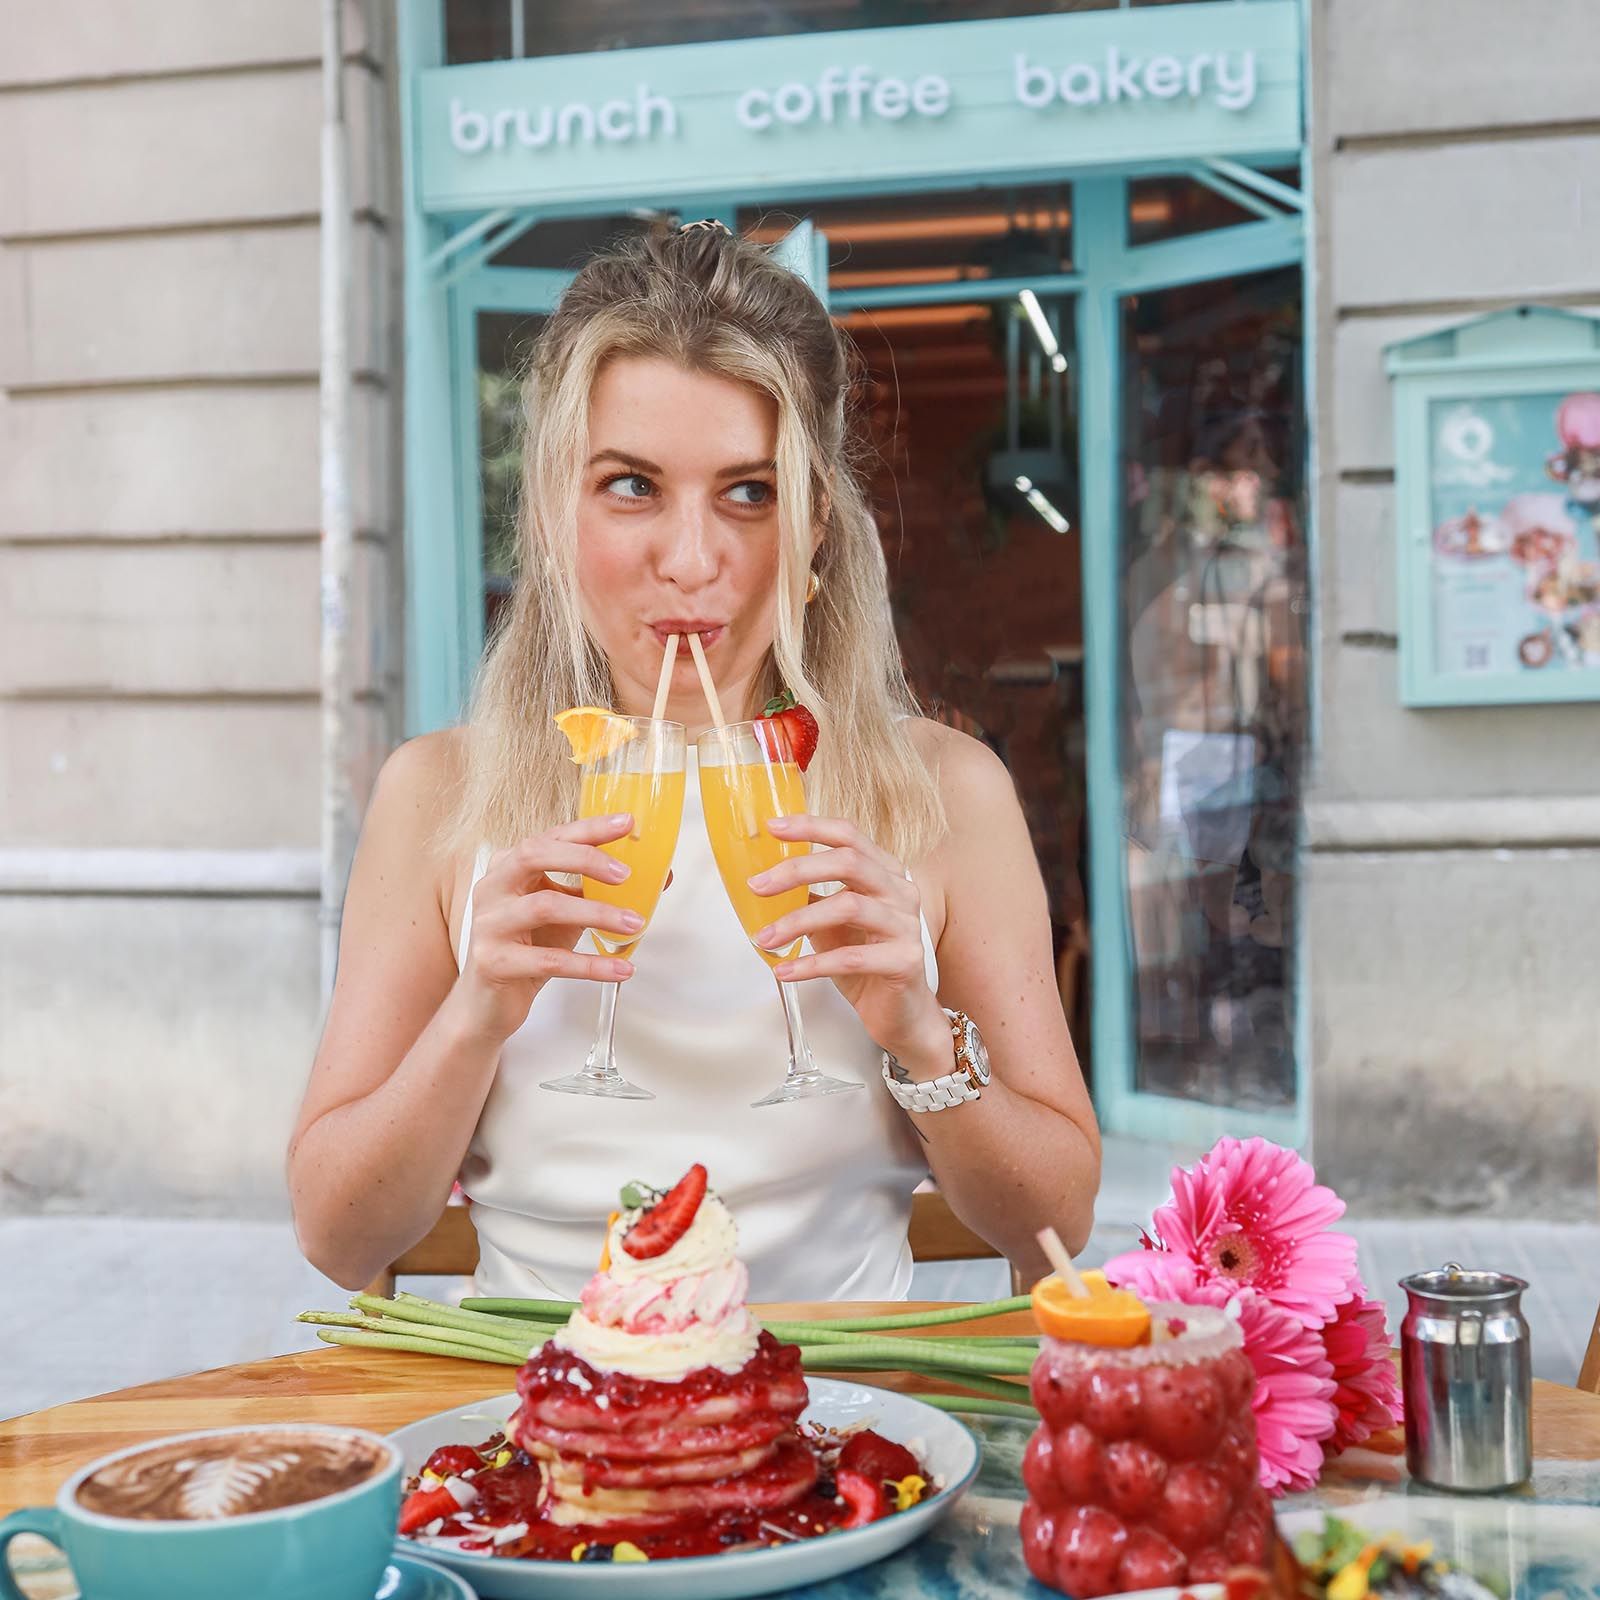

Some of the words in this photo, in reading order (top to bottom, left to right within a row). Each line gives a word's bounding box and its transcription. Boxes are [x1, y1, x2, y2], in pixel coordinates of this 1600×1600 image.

[450, 84, 677, 152] brunch
[737, 66, 951, 130] coffee
[1014, 46, 1256, 111] bakery
